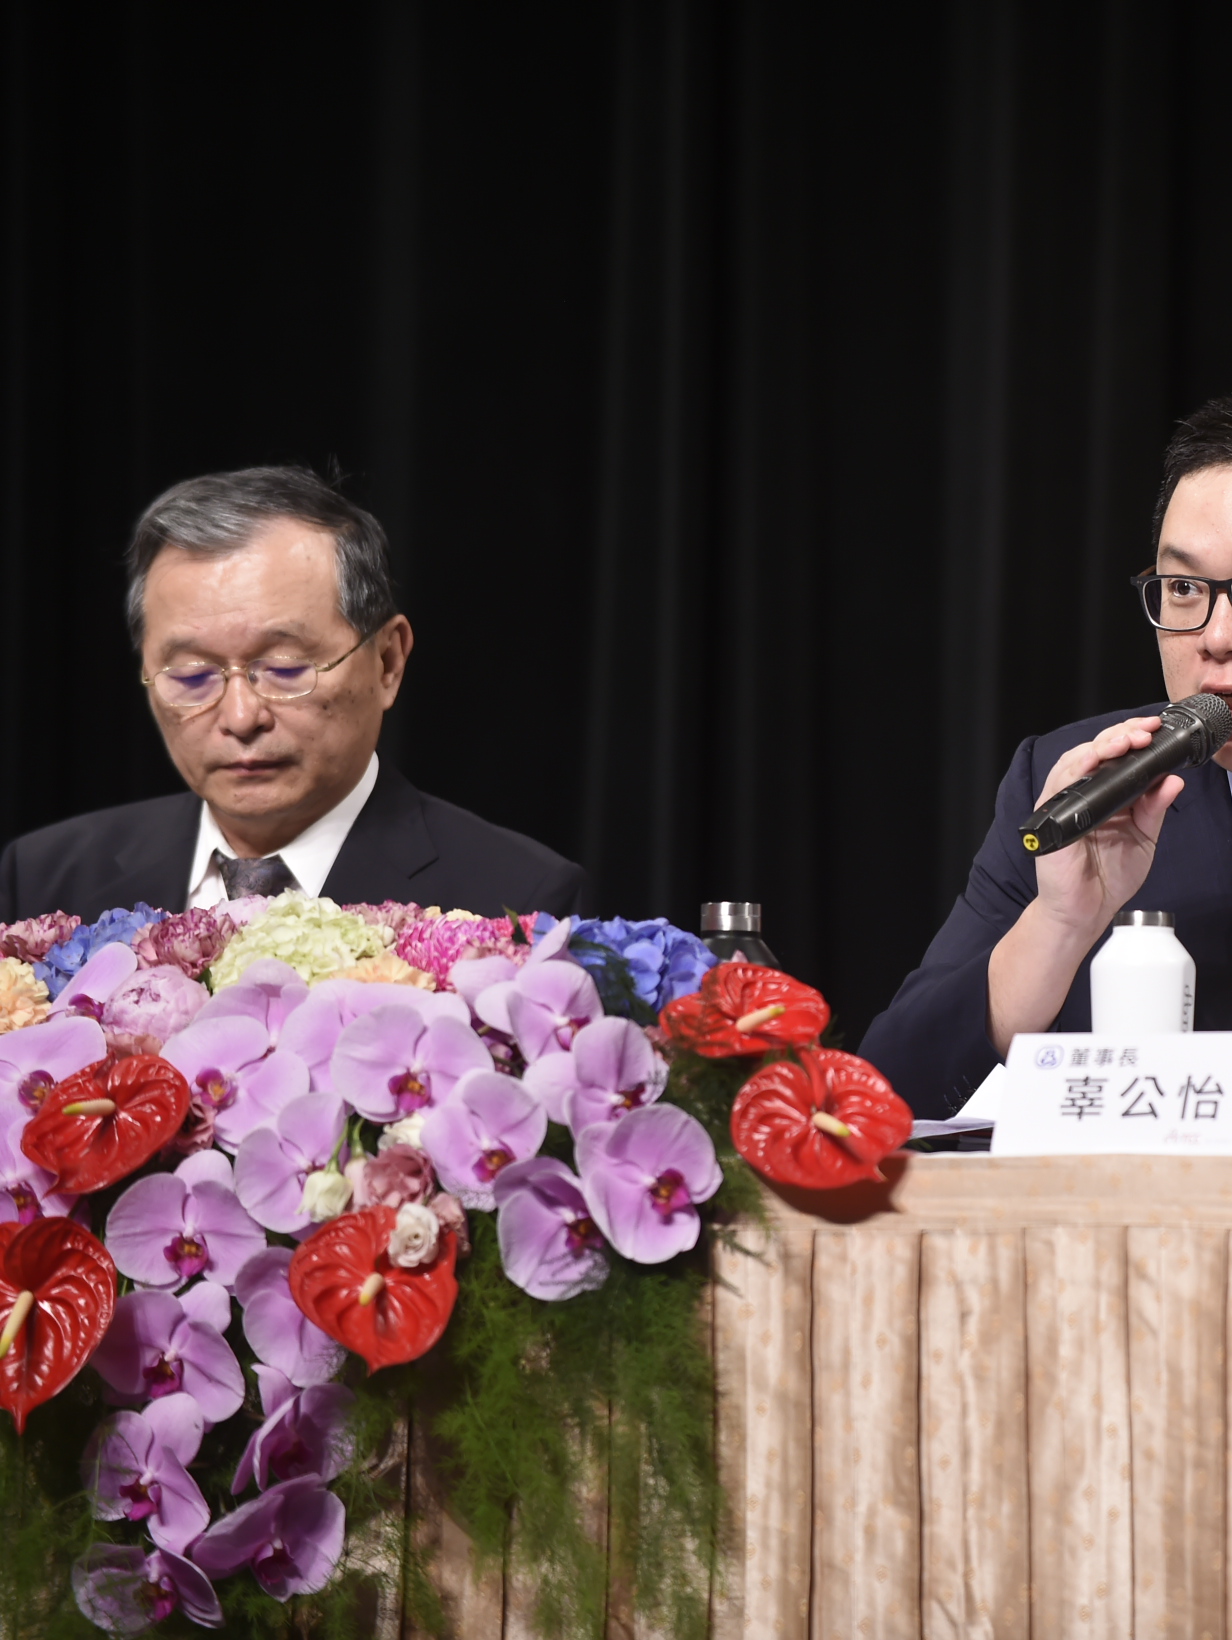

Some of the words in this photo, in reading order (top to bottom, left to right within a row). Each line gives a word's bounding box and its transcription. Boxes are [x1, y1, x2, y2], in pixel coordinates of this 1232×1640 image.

[1069, 1047, 1139, 1067] 董事長
[1060, 1075, 1224, 1121] 辜公怡
